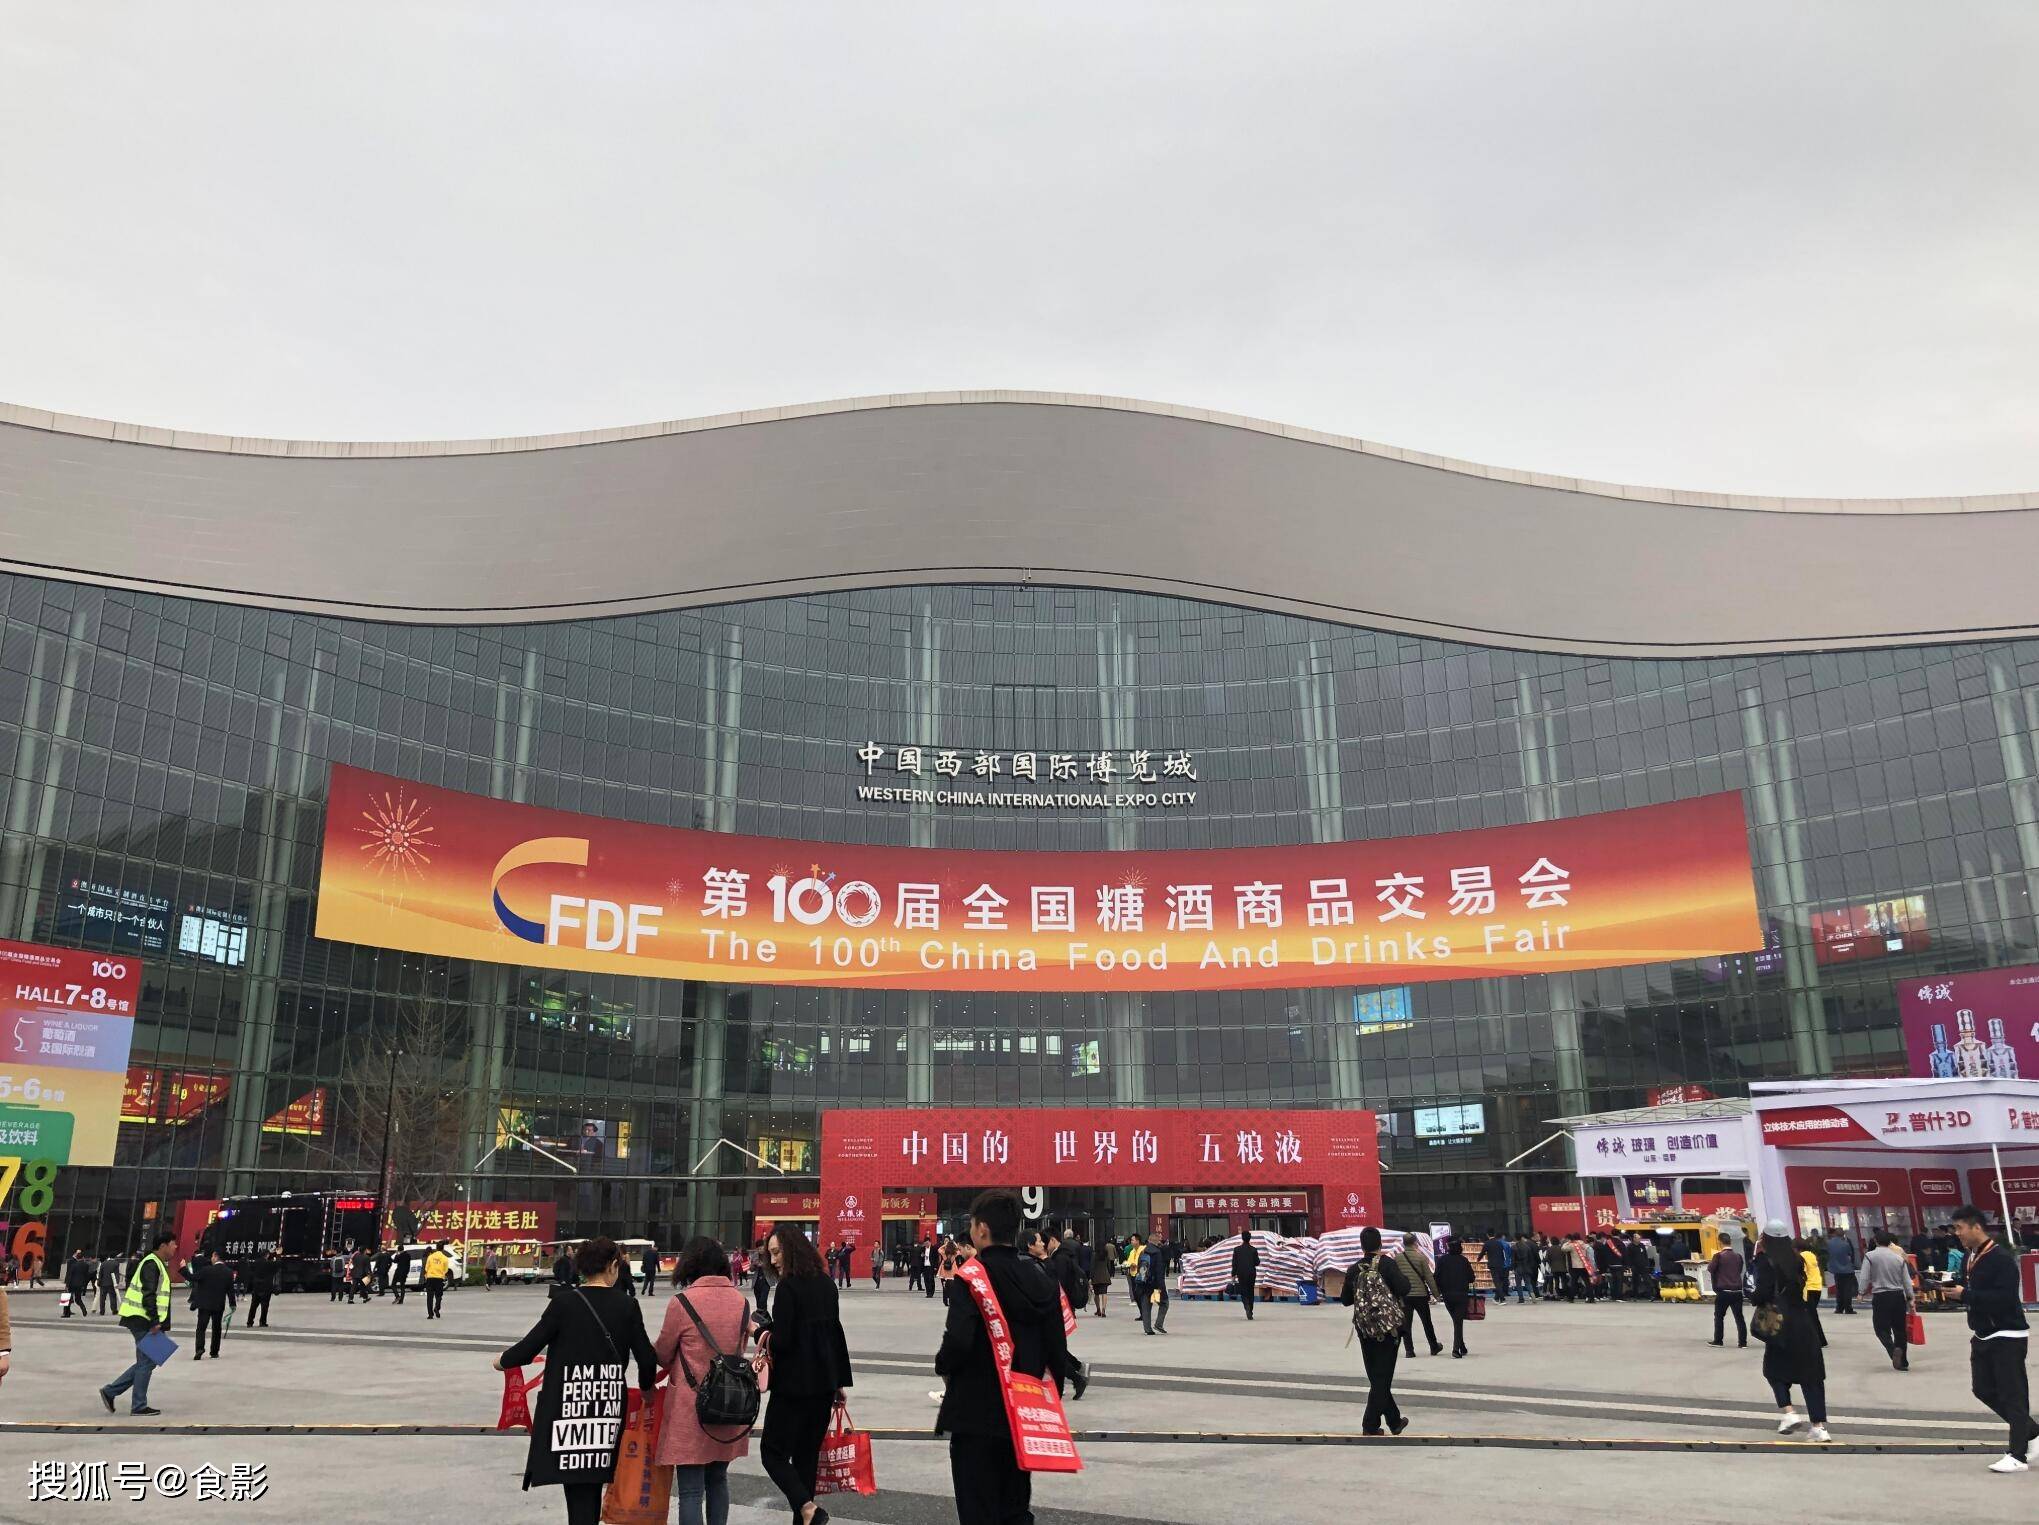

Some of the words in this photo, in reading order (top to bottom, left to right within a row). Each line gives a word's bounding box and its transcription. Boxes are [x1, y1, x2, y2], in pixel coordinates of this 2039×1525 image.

[857, 741, 1198, 783] 中国西部国际博览城
[858, 785, 934, 804] WESTERN
[936, 790, 985, 805] CHINA
[987, 792, 1112, 808] INTERNATIONAL
[1114, 792, 1157, 808] EXPO
[1161, 791, 1197, 806] CITY
[701, 857, 1571, 934] 第100届全国糖酒商品交易会
[701, 928, 777, 963] The
[809, 935, 900, 968] 100th
[920, 940, 1038, 971] China
[1068, 940, 1168, 972] Food
[1199, 938, 1280, 970] And
[1312, 931, 1452, 966] Drinks
[1484, 920, 1571, 955] Fair
[91, 960, 127, 980] 100
[902, 1129, 1010, 1166] 中国的
[1052, 1129, 1159, 1165] 世界的
[1198, 1129, 1303, 1165] 五粮液
[1666, 1134, 1719, 1150] 创造价值
[20, 1157, 58, 1216] 8
[1021, 1185, 1044, 1220] 9
[1194, 1198, 1240, 1208] 国香典范
[11, 1221, 48, 1281] 6
[564, 1365, 568, 1381] I
[571, 1365, 594, 1380] AM
[600, 1364, 622, 1380] NOT
[562, 1401, 590, 1418] BUT
[594, 1401, 599, 1416] I
[603, 1401, 621, 1417] AM
[560, 1452, 611, 1470] EDITIO
